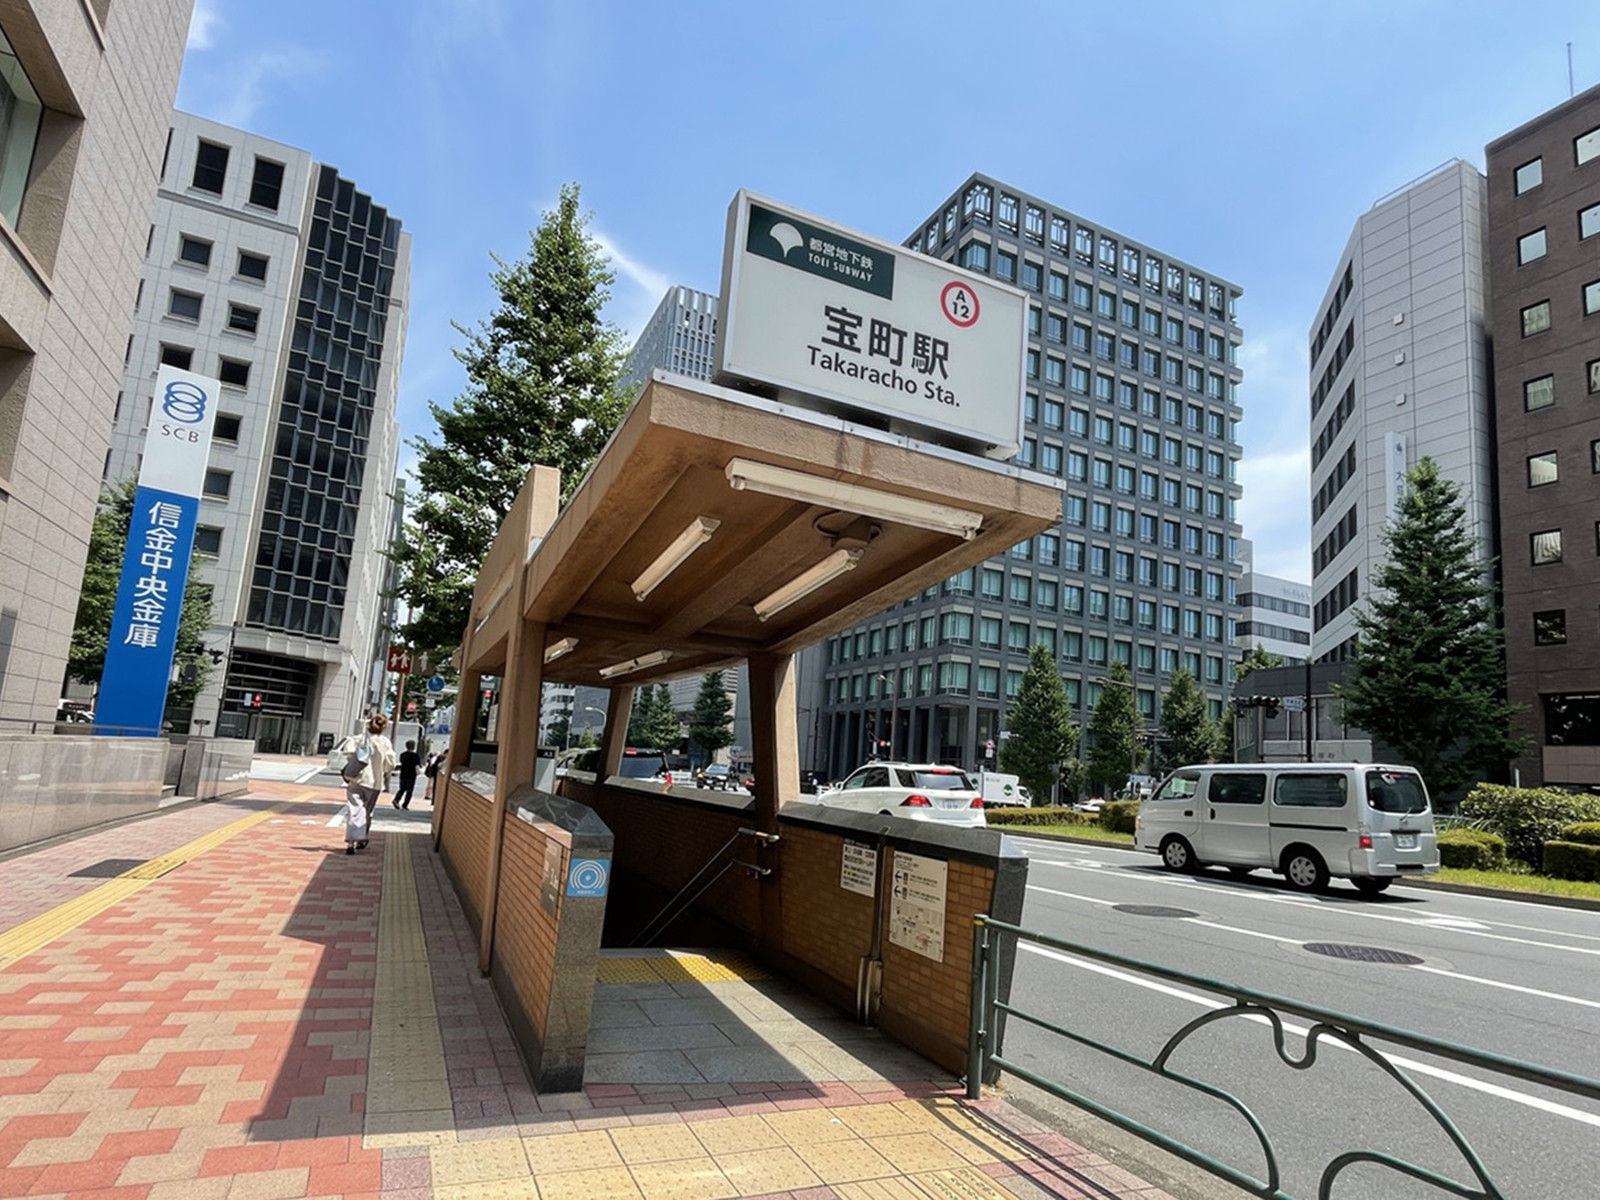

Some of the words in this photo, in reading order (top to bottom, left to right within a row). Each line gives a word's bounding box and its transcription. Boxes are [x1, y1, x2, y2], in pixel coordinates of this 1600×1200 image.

[808, 252, 830, 268] TOEI
[833, 261, 873, 282] SUBWAY
[809, 237, 873, 271] 都営地下鉄
[952, 301, 970, 319] 12
[955, 289, 967, 303] A
[821, 305, 949, 380] 宝町駅
[807, 345, 918, 395] Takaracho
[924, 381, 960, 408] Sta.
[161, 424, 200, 444] SCB
[124, 501, 182, 648] 信金中央金庫
